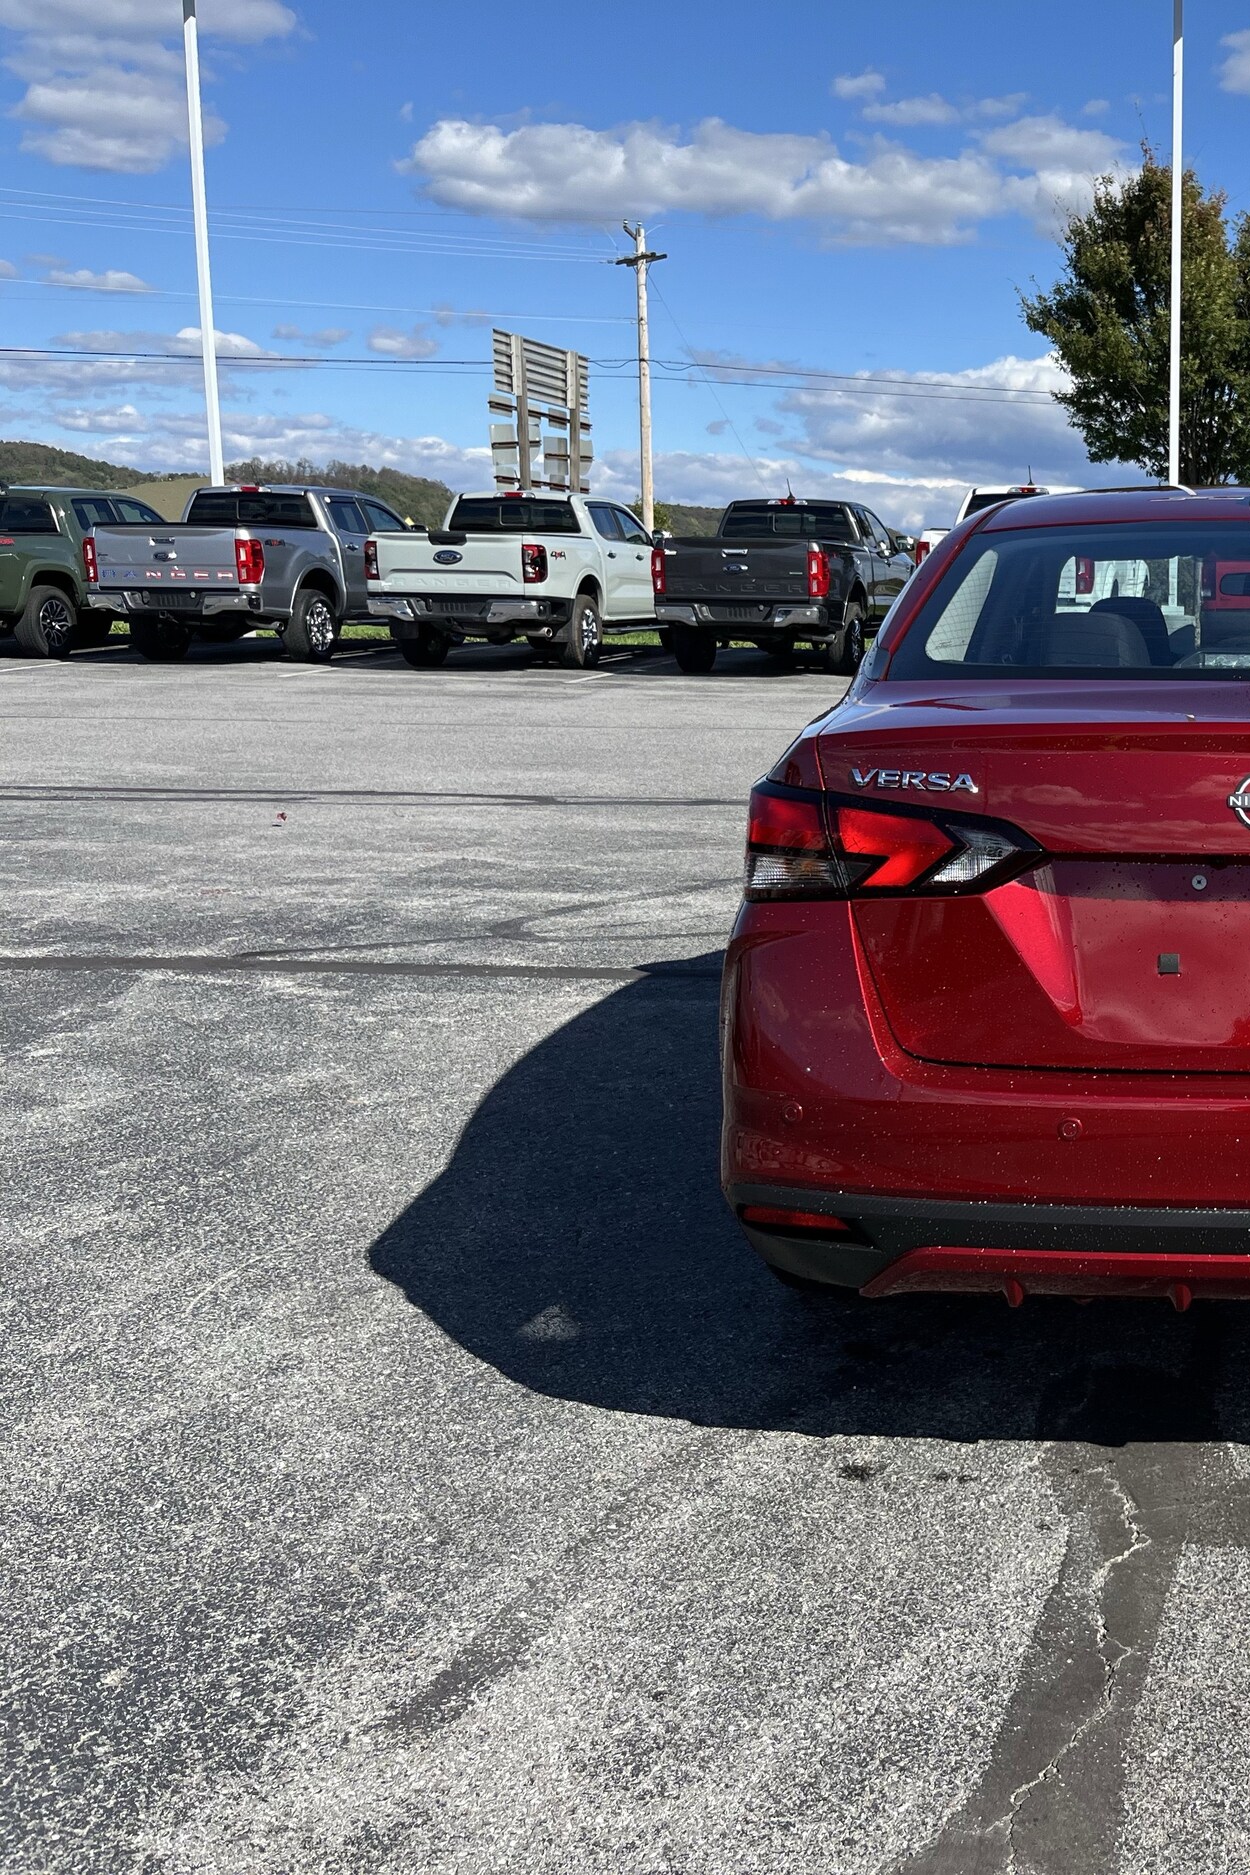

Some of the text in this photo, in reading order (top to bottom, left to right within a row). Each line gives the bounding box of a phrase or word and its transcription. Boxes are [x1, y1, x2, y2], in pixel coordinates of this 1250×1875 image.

[390, 577, 512, 589] RANGER
[671, 583, 805, 593] RANGER
[851, 768, 979, 794] VERSA
